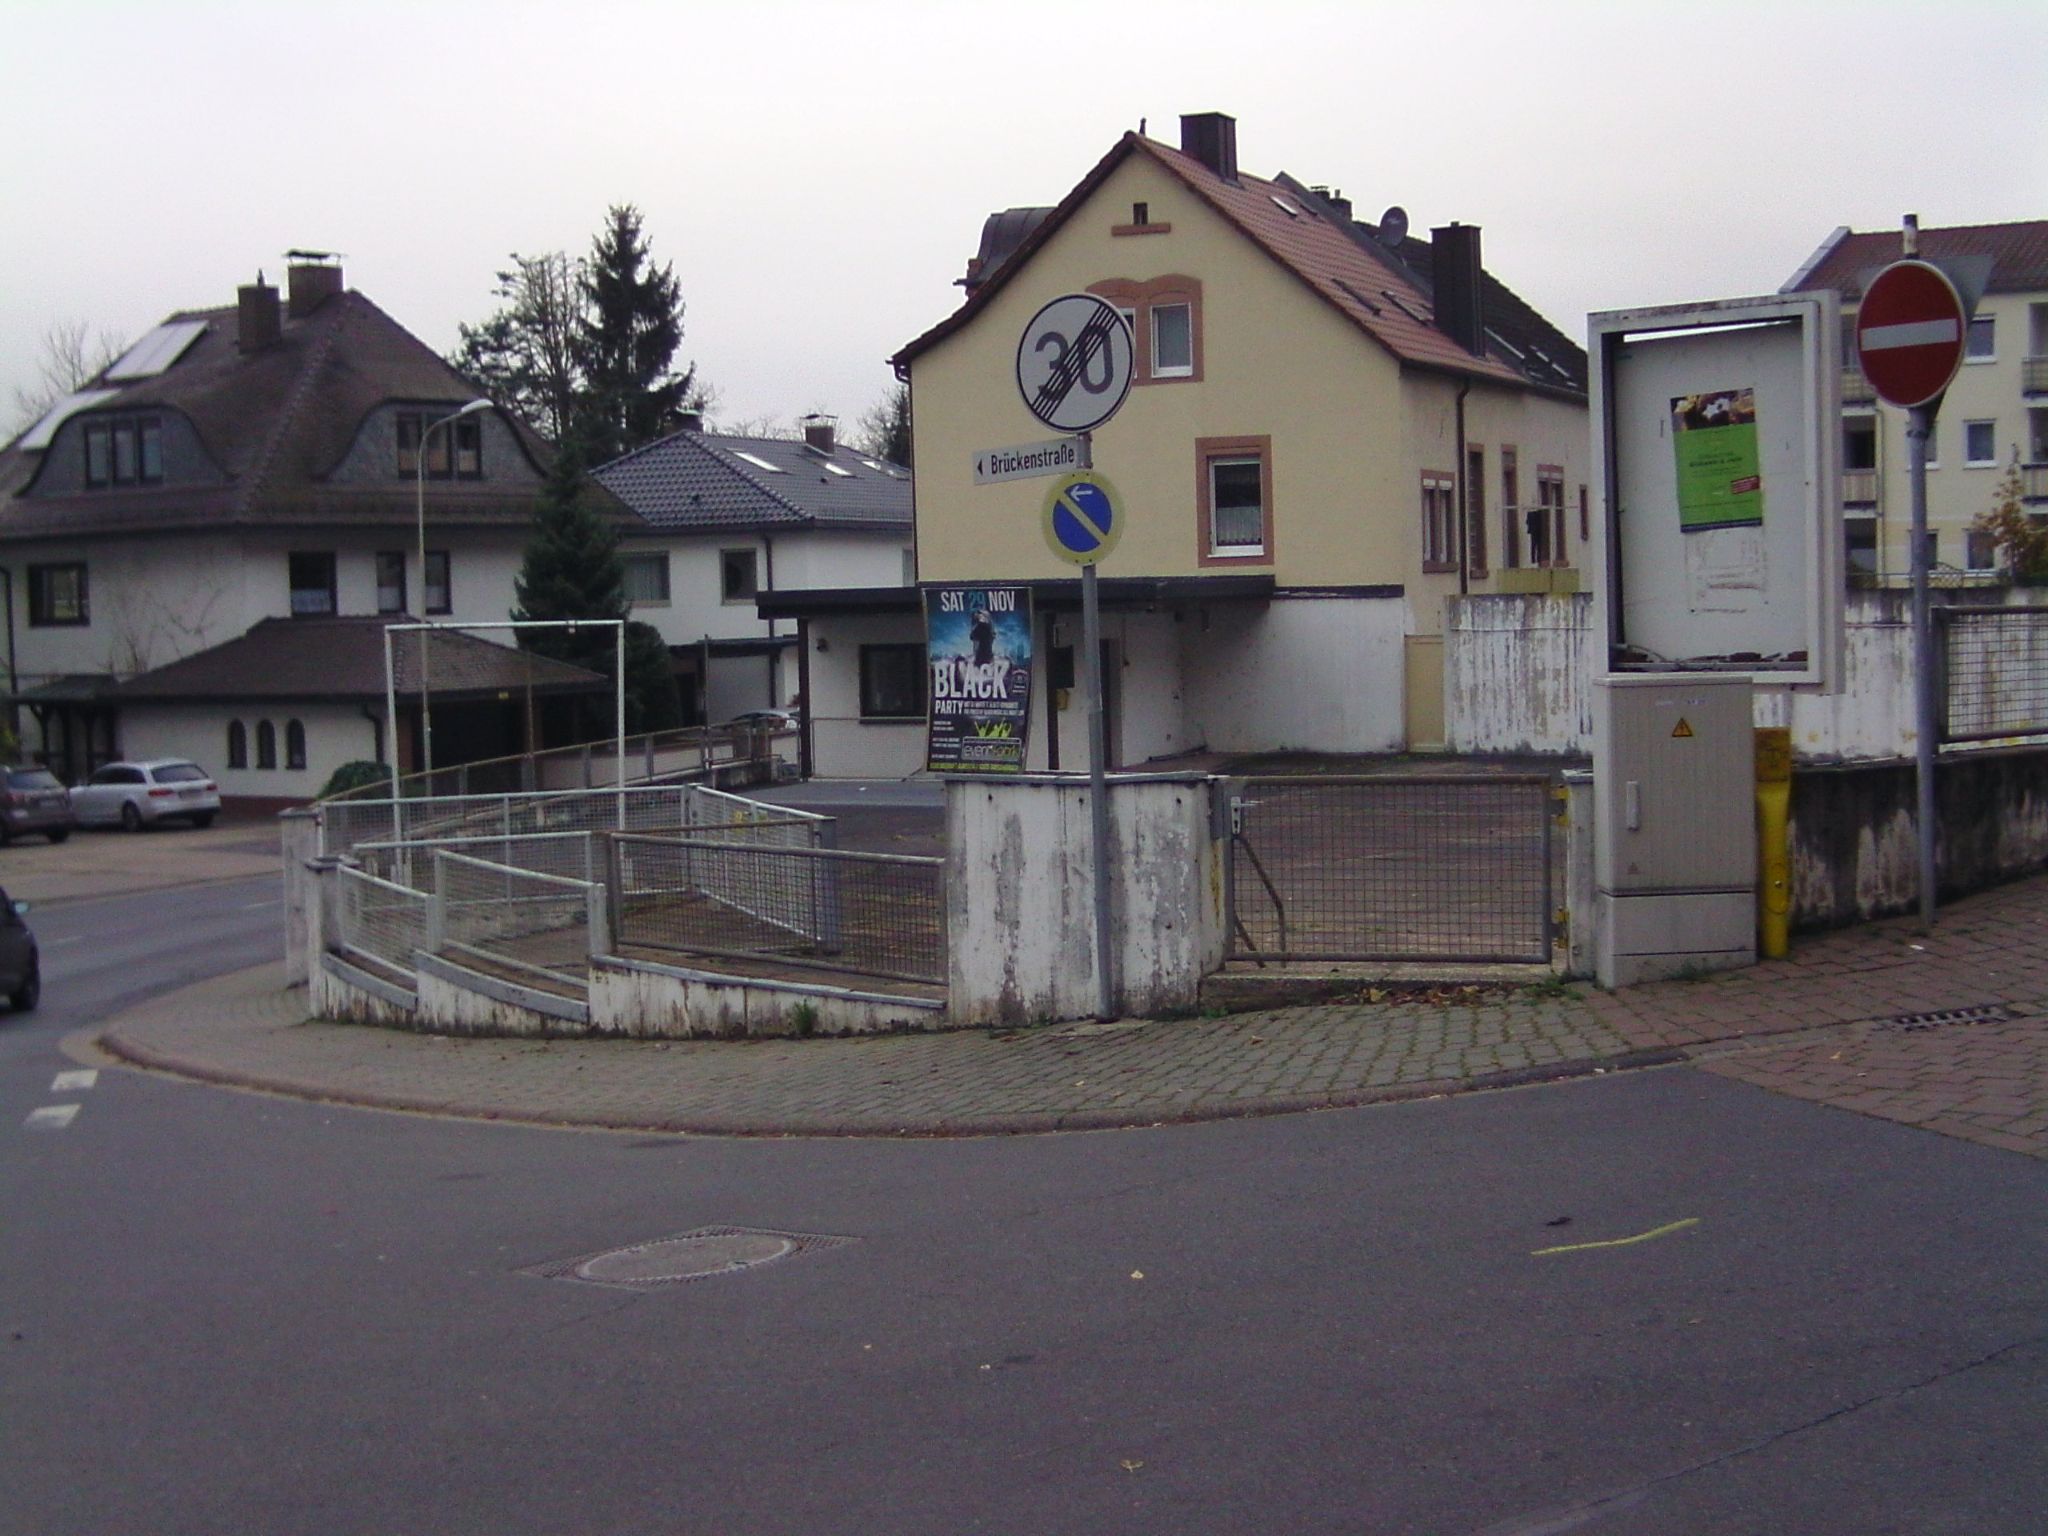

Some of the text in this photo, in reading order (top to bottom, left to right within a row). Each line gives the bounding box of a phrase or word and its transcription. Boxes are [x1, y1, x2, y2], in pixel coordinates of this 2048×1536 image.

[1034, 323, 1114, 402] 30
[991, 444, 1075, 475] Brückenstraße
[940, 590, 1015, 612] SAT 29 NOV
[934, 661, 1010, 699] BLACK
[935, 699, 964, 715] PARTY
